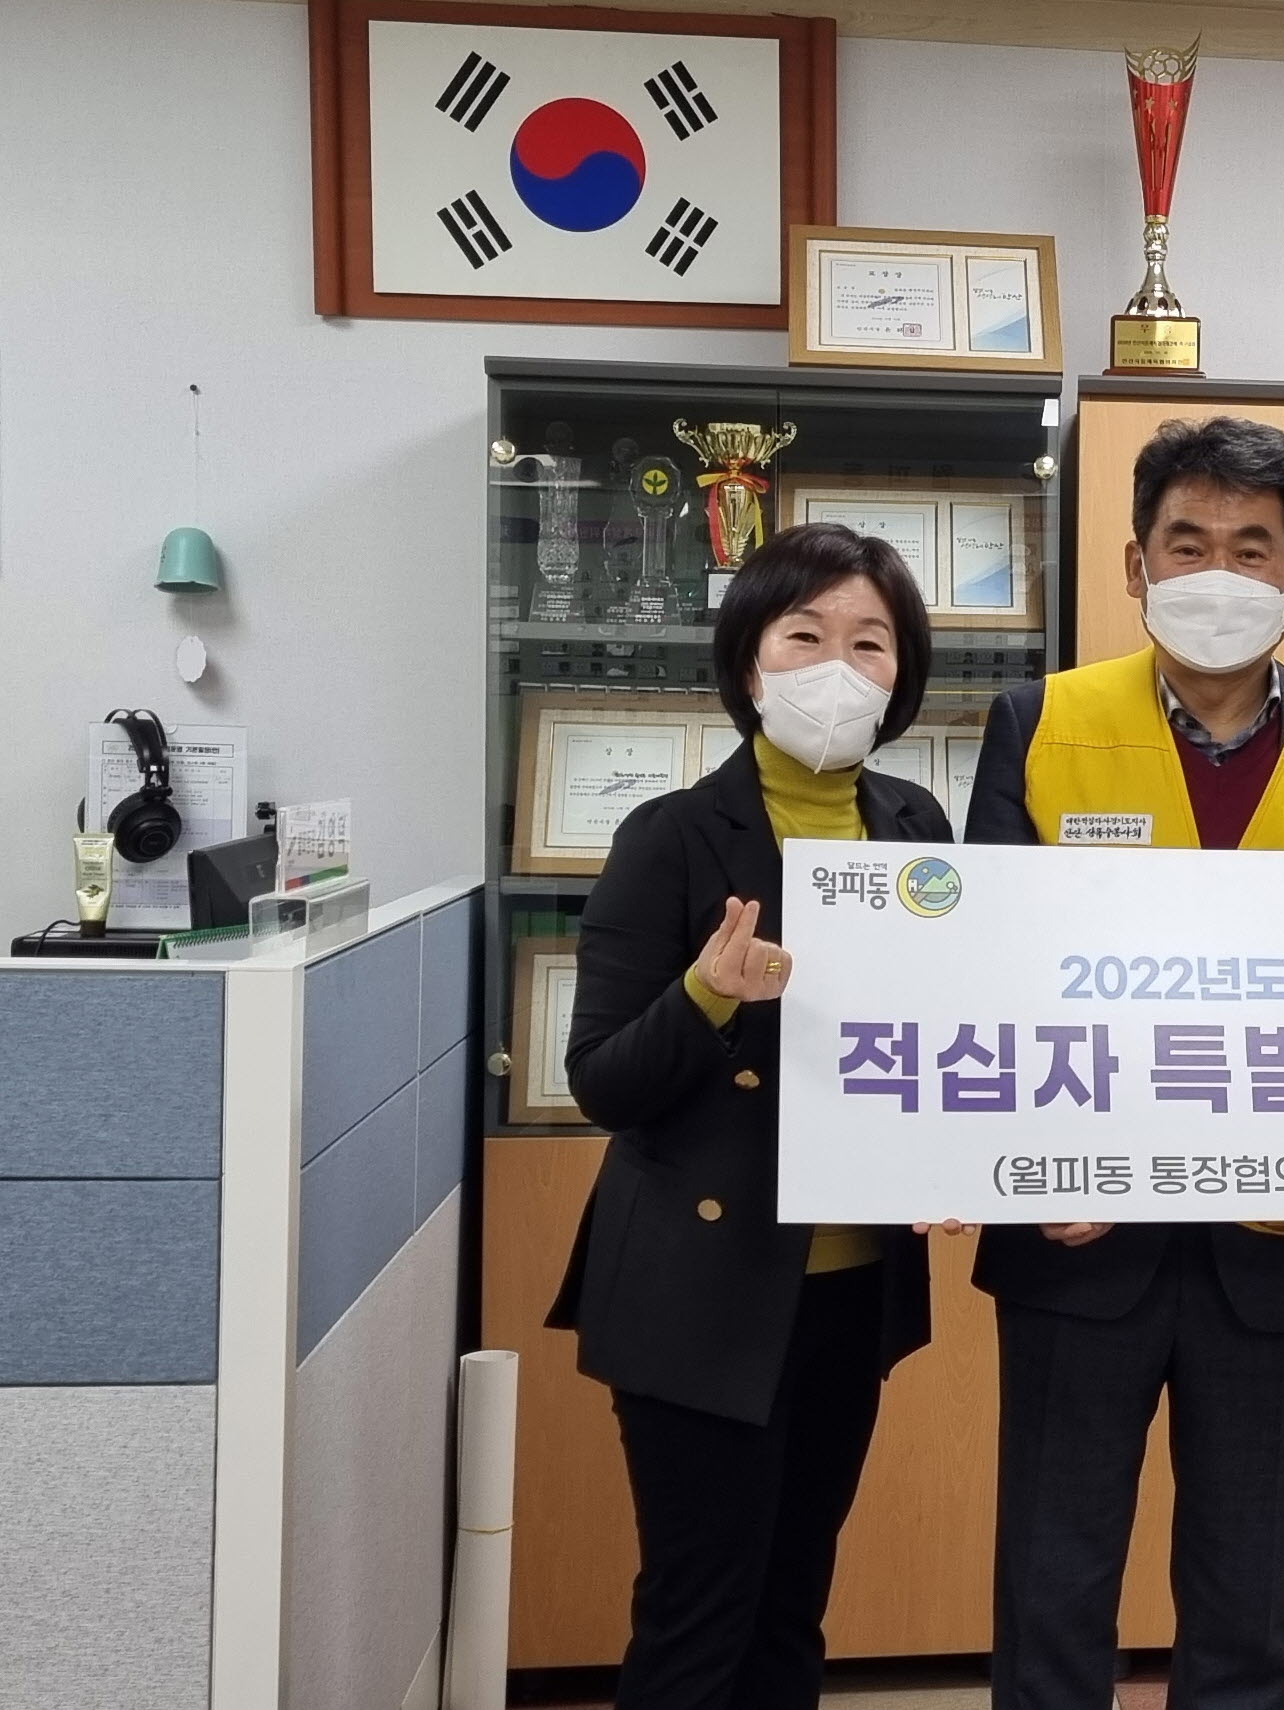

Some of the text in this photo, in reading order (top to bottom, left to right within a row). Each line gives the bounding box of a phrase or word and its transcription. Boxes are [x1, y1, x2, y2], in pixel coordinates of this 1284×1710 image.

[812, 866, 890, 910] 월피동
[838, 1021, 1119, 1113] 적십자
[992, 1155, 1133, 1197] (월피동
